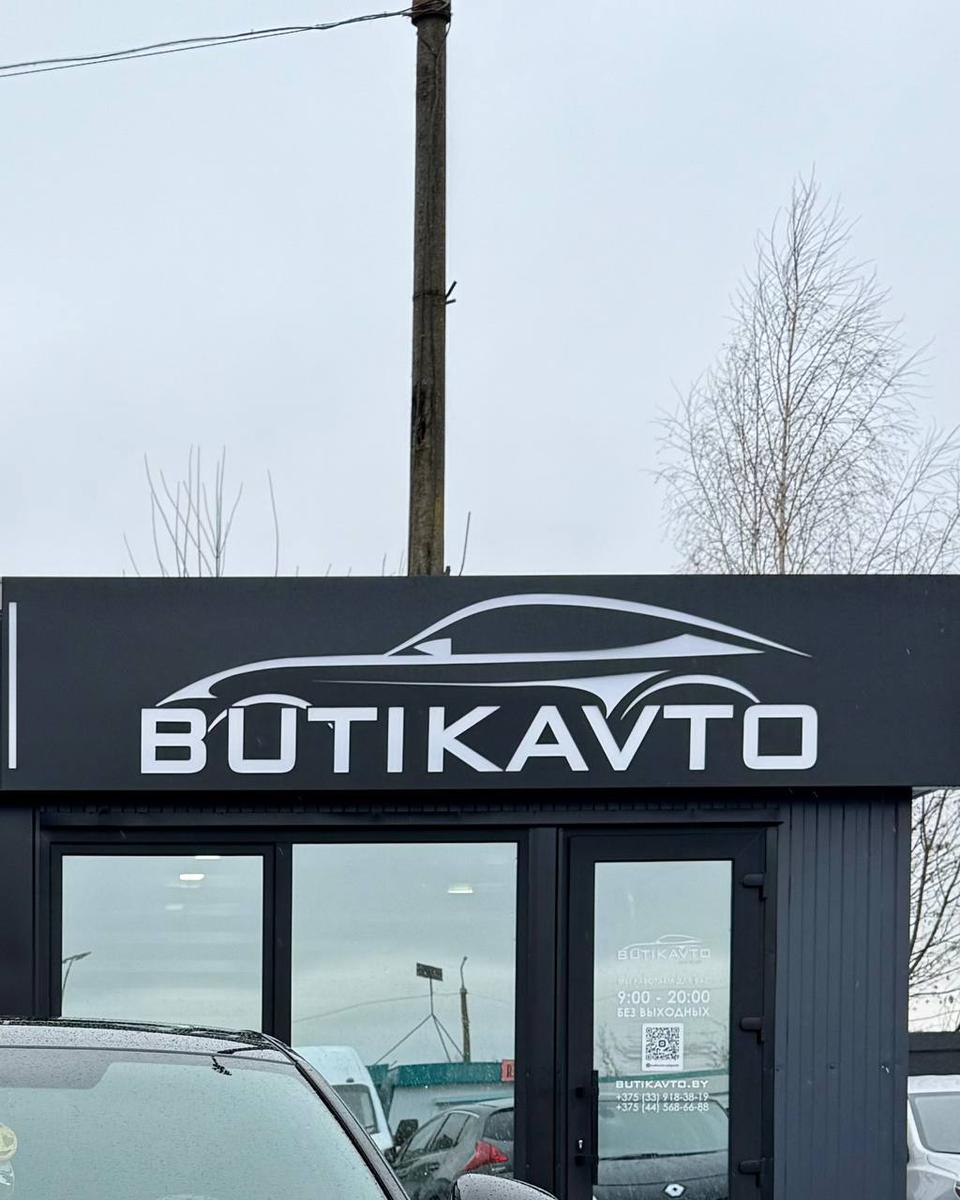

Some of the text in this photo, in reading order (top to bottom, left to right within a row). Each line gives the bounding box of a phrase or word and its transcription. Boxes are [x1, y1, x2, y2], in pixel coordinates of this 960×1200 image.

[140, 703, 819, 775] BUTIKAVTO
[617, 948, 711, 960] BUTIKAVTO
[618, 991, 650, 1004] 9:00
[667, 990, 710, 1004] 20:00
[617, 1007, 710, 1018] БЕЗ ВЫХОДНЫХ
[615, 1080, 708, 1088] BUTIKAVTO.BY
[616, 1092, 709, 1103] +375 (33) 918-38-19
[616, 1102, 709, 1113] +375 (44) 568-66-88
